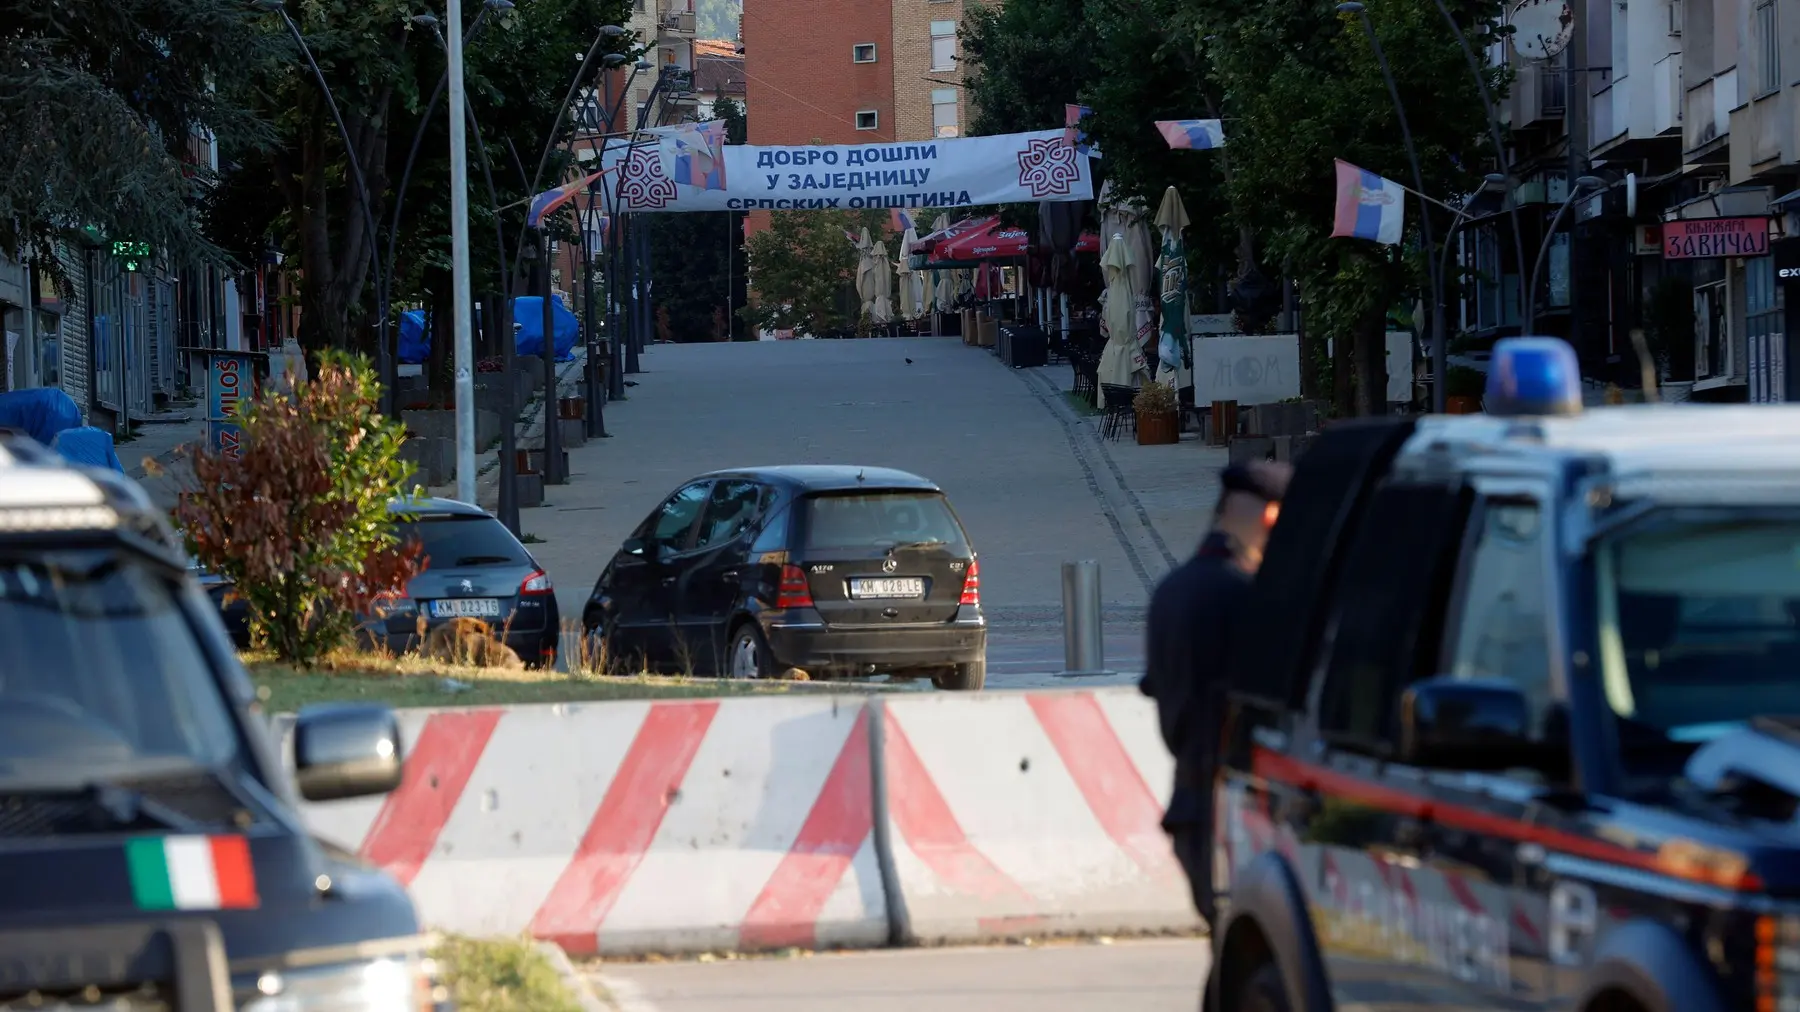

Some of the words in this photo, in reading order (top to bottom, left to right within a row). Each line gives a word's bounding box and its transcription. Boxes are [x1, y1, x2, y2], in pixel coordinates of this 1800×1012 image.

[757, 150, 840, 169] ДОБРО
[846, 145, 938, 166] ДОШЛИ
[766, 174, 781, 190] У
[788, 168, 931, 191] ЗАЈЕДНИЦУ
[727, 197, 842, 209] СРПСКИХ
[849, 190, 974, 209] ОПШТИНА
[1685, 220, 1745, 234] КЊИЖАРА
[1668, 231, 1766, 257] ЗАВИЧАЈ
[1778, 267, 1800, 278] ex
[859, 579, 875, 594] KM
